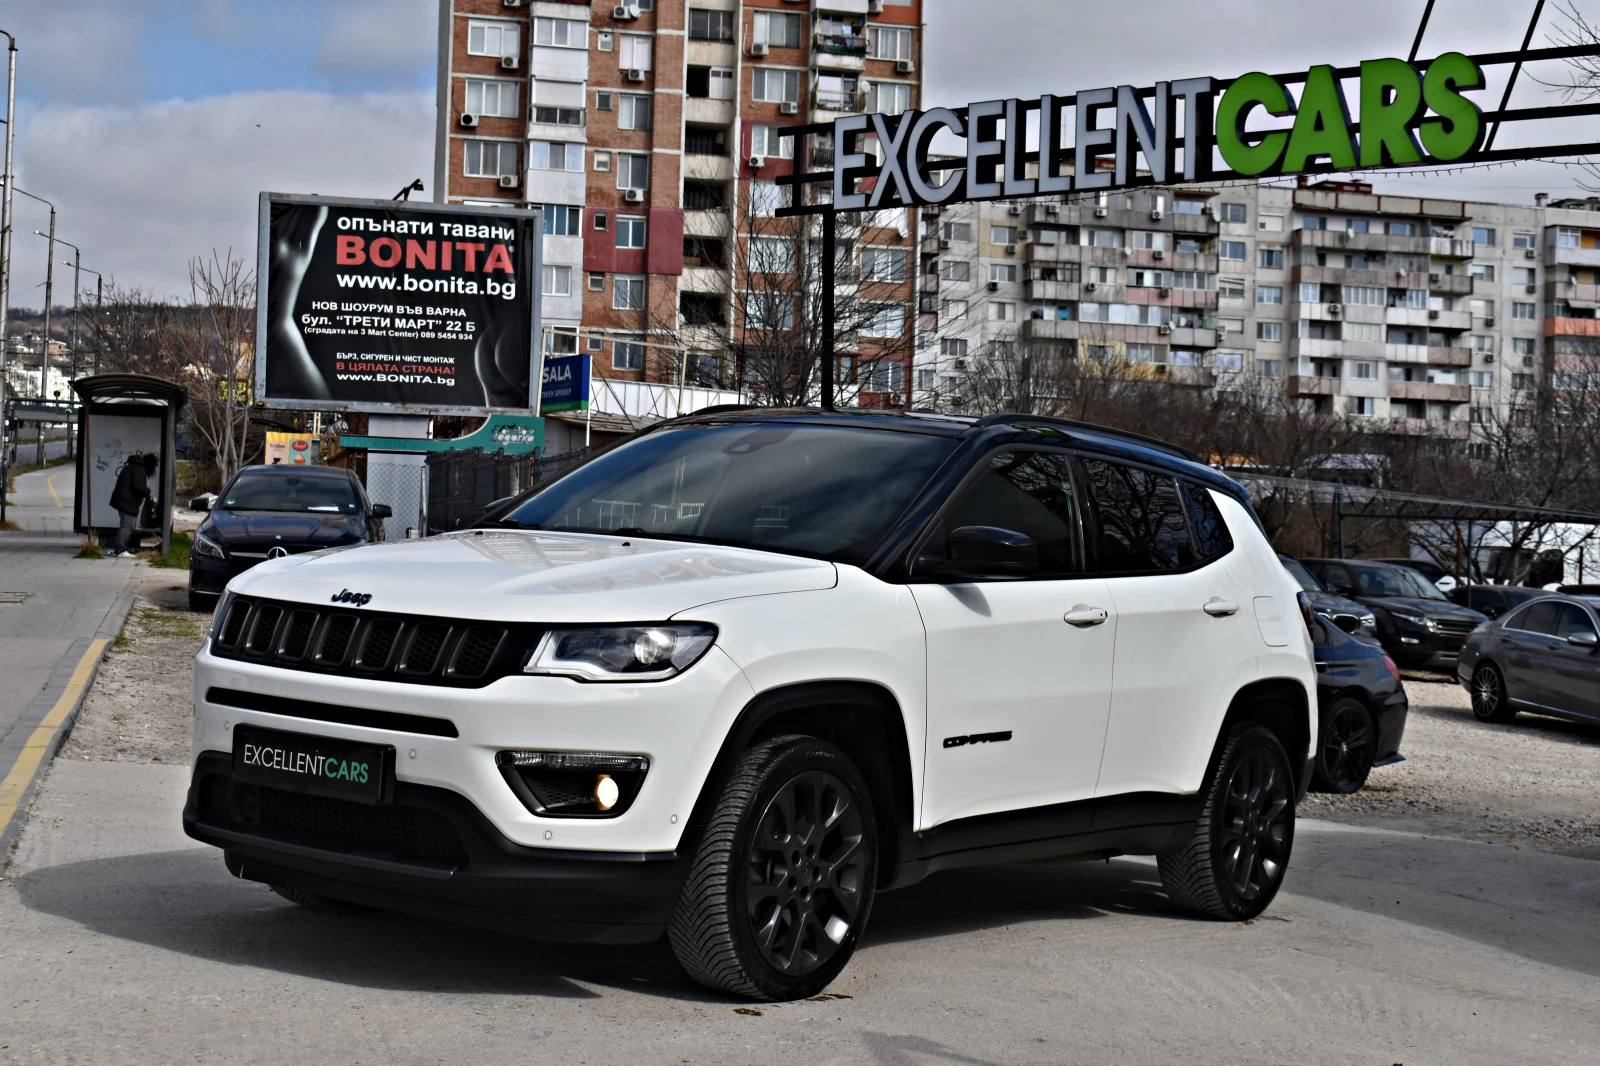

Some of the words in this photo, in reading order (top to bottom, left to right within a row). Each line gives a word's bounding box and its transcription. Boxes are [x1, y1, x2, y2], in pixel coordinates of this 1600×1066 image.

[337, 216, 434, 235] опънати
[440, 222, 515, 240] тавани
[336, 274, 516, 300] www.bonita.bg
[312, 301, 338, 311] НОВ
[341, 303, 393, 313] ШОУРУМ
[396, 306, 423, 315] ВЪВ
[427, 307, 466, 317] ВАРНА
[302, 314, 332, 326] бул.
[446, 321, 461, 331] 22
[304, 326, 346, 334] (сградата
[368, 329, 386, 337] Mart
[388, 330, 419, 338] Center)
[336, 362, 345, 370] В
[348, 363, 398, 372] ЦЯЛАТА
[402, 365, 455, 374] СТРАНА!
[423, 356, 455, 364] МОНТАЖ
[337, 374, 455, 386] www.BONITA.bg
[331, 588, 372, 607] Jeep
